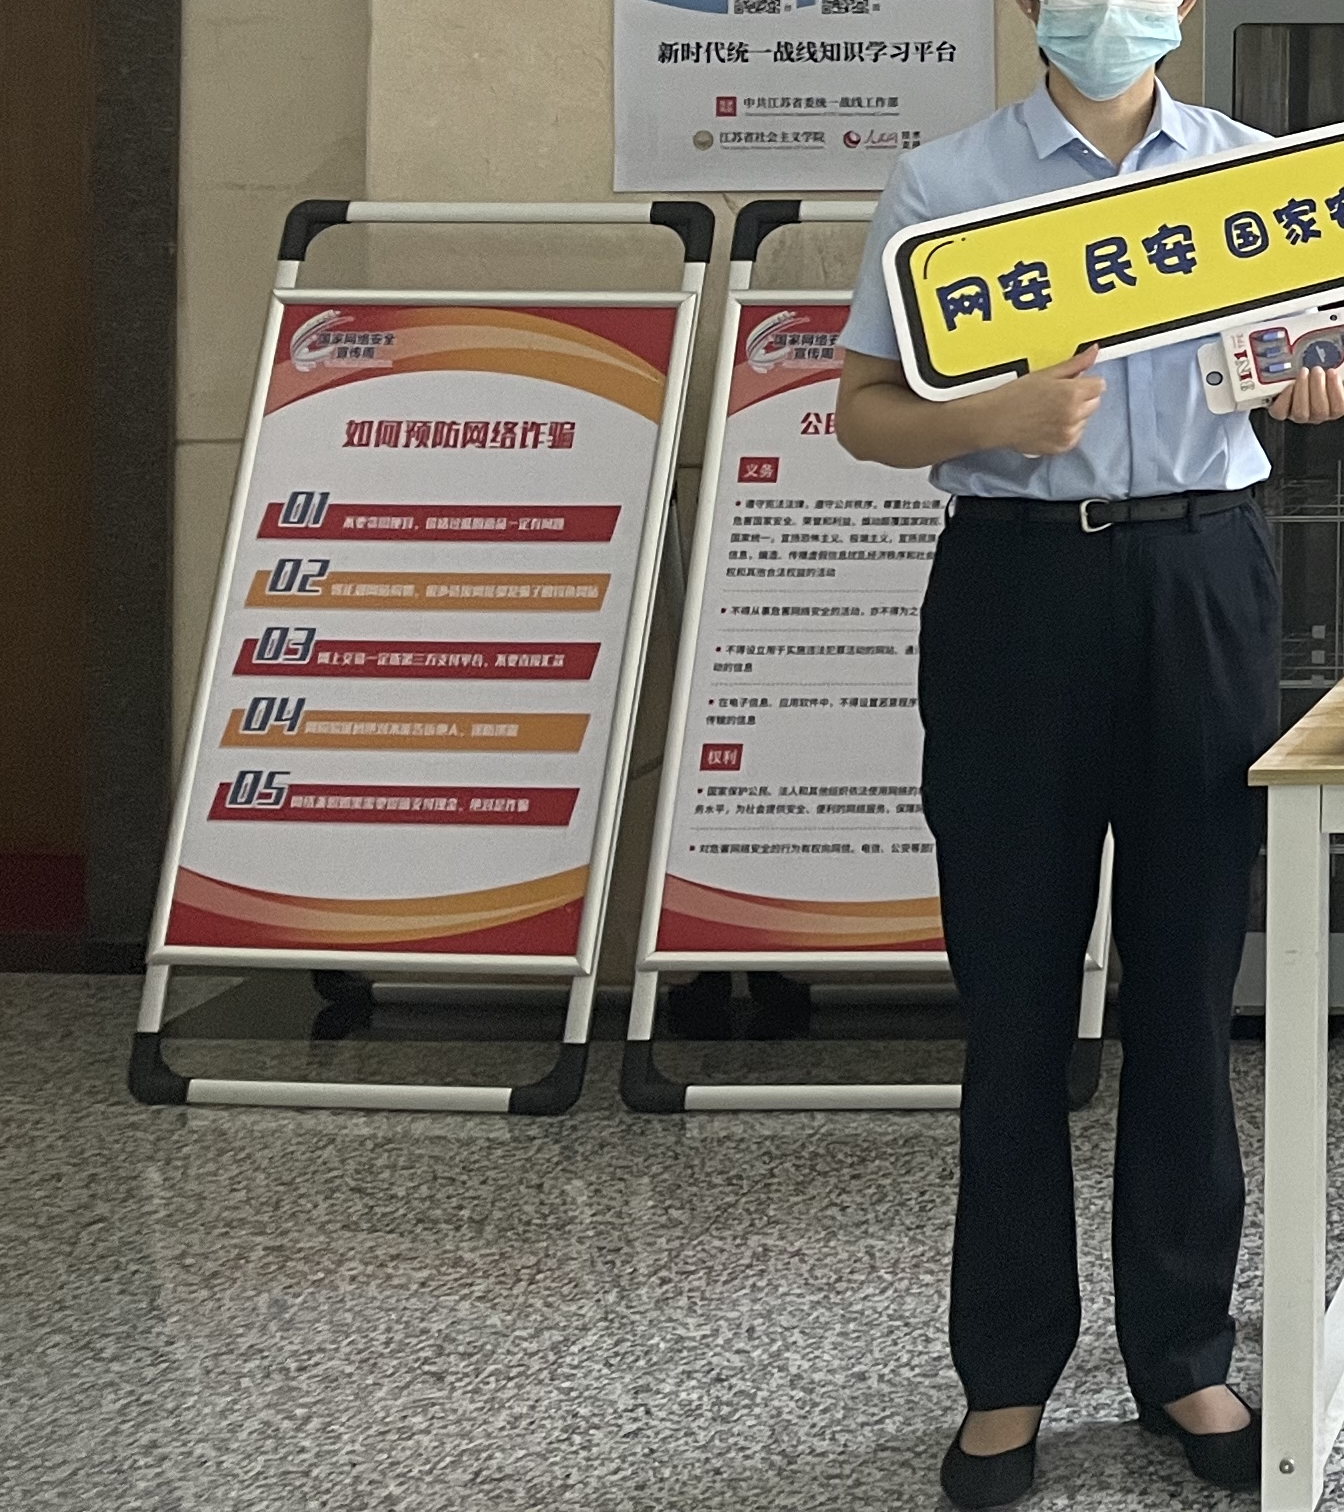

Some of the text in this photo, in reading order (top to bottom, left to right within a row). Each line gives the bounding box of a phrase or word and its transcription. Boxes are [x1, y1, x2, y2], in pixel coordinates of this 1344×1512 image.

[658, 41, 957, 64] 新时代统一战线知识学习平台
[719, 131, 825, 144] 江苏省社会主义学院
[936, 260, 1053, 332] 网安
[1085, 223, 1199, 294] 民安
[317, 331, 396, 346] 国家网络安全
[336, 347, 375, 359] 宣传周
[793, 347, 835, 360] 宣传周
[342, 419, 577, 449] 如何预防网络诈骗
[744, 463, 774, 479] 义务
[281, 491, 331, 527] 01
[268, 558, 330, 594] 02
[254, 627, 317, 662] 03
[241, 696, 306, 733] 04
[707, 749, 738, 765] 权利
[227, 770, 291, 807] 05
